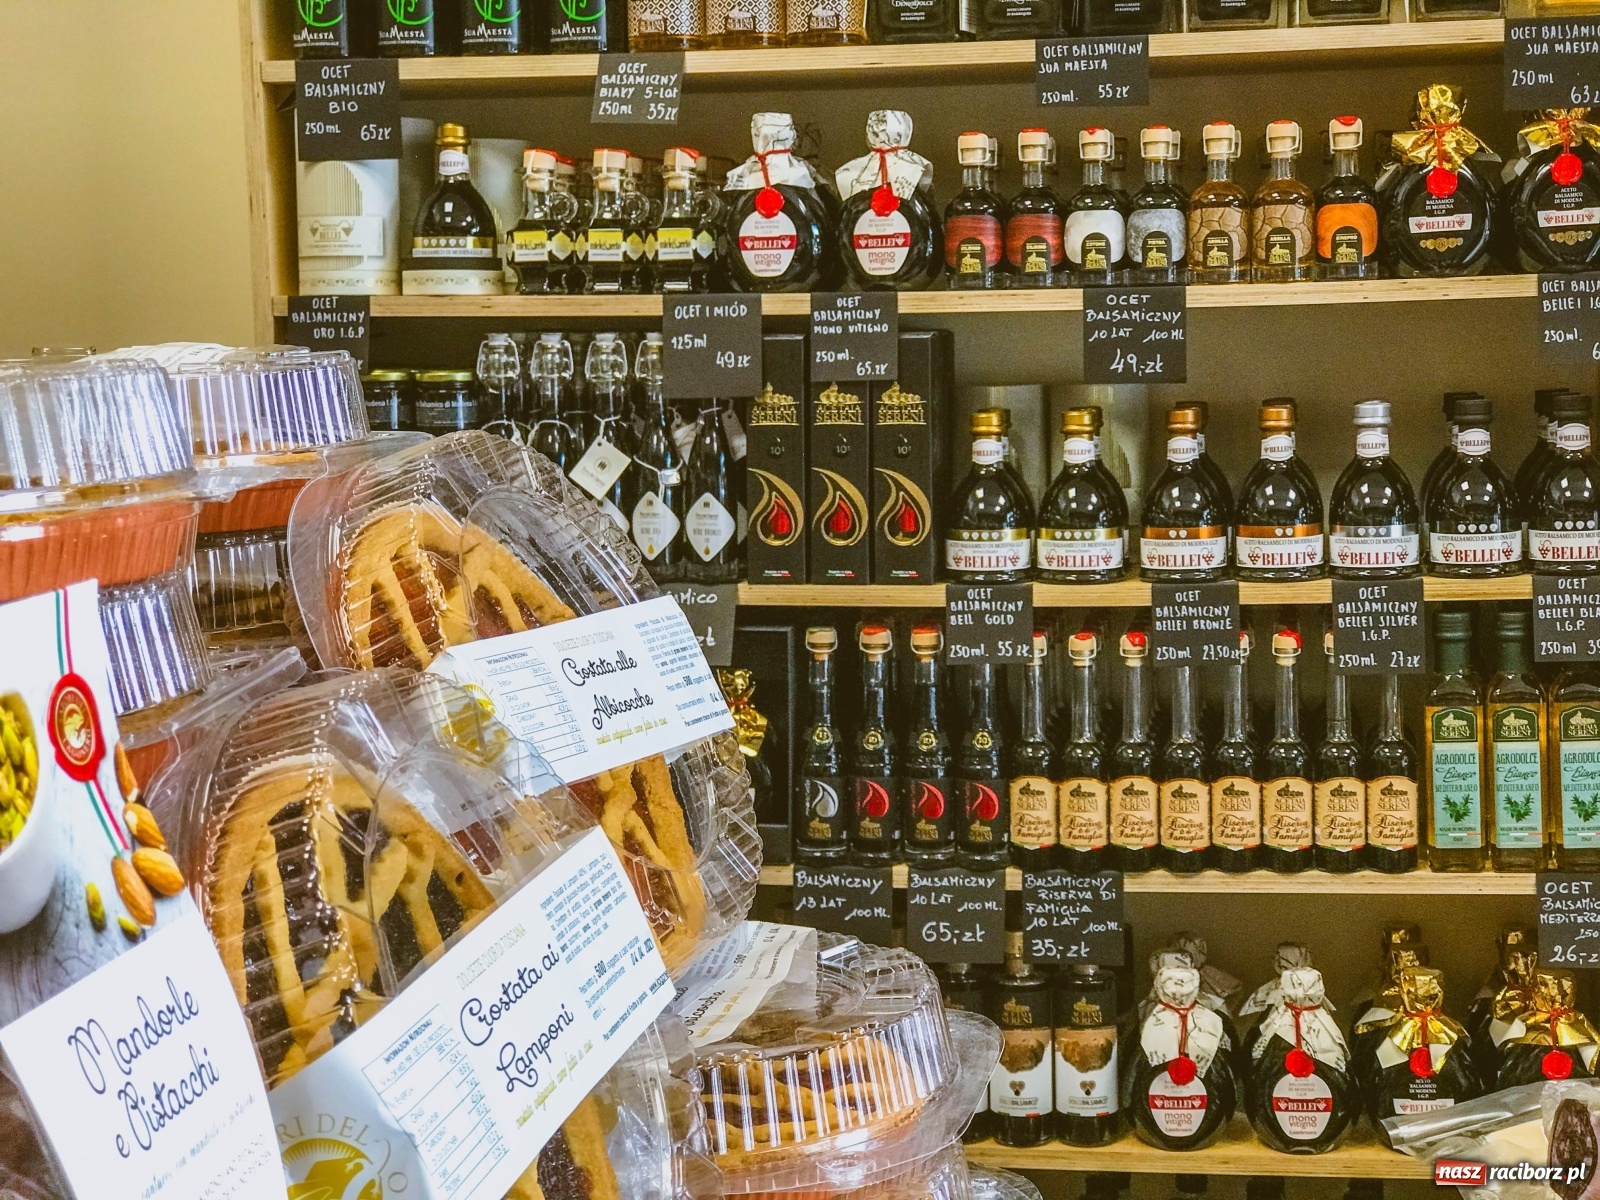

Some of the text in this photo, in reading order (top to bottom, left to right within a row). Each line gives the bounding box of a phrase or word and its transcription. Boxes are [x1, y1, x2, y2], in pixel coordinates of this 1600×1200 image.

[1511, 26, 1538, 41] OCET
[1043, 42, 1144, 60] OCET BALSAMICZNY
[1525, 41, 1600, 56] SUA MAESTA
[321, 65, 352, 79] OCET
[618, 62, 648, 75] OCET
[1039, 59, 1109, 75] SUA MAESTA
[601, 73, 678, 87] BALSAMICZNY
[304, 81, 386, 98] BALSAMICZNY
[329, 101, 358, 114] BIO
[1425, 220, 1456, 230] BELLEI
[1554, 213, 1585, 224] BELLEI
[753, 237, 783, 249] BELLEI
[867, 236, 896, 248] BELLEI
[754, 258, 782, 267] vitigno
[868, 256, 896, 266] vitigno
[1542, 279, 1566, 294] OCET
[312, 297, 339, 310] OCET
[836, 297, 862, 308] OCET
[1106, 294, 1152, 306] OCET
[1543, 297, 1581, 312] BELLEI
[674, 305, 700, 320] OCET
[714, 301, 748, 318] MIÓD
[814, 309, 881, 322] BALSAMICZNY
[292, 311, 365, 324] BALSAMICZNY
[313, 327, 335, 339] ORO
[814, 323, 889, 335] MONO VITIGNO
[1088, 329, 1108, 342] 10
[1111, 326, 1134, 339] LAT
[1142, 329, 1169, 343] 100
[751, 412, 797, 424] SERENI
[816, 412, 862, 424] SERENI
[878, 412, 925, 424] SERENI
[1465, 439, 1487, 447] BELLEI
[1563, 434, 1586, 442] BELLEI
[1056, 555, 1101, 568] BELLEI
[1158, 554, 1202, 568] BELLEI
[1262, 552, 1307, 567] BELLEI
[1350, 548, 1396, 565] BELLEI
[1454, 547, 1501, 563] BELLEI
[964, 555, 1008, 569] BELLEI
[1558, 578, 1588, 590] OCET
[967, 588, 993, 600] OCET
[1175, 590, 1202, 602] OCET
[1359, 586, 1389, 600] OCET
[950, 600, 1024, 612] BALSAMICZNY
[1155, 605, 1230, 618] BALSAMICZNY
[1338, 601, 1418, 614] BALSAMICZNY
[1538, 607, 1574, 619] BELLEI
[985, 614, 1014, 626] GOLD
[1155, 618, 1234, 631] BELLEI BRONZE
[1338, 615, 1418, 628] BELLEI SILVER
[1556, 620, 1586, 631] I.G.P.
[1362, 629, 1391, 642] I.G.P.
[561, 650, 638, 687] Crostata alle
[592, 687, 654, 730] Albicocche
[1435, 753, 1478, 765] AGRODOLCE
[1496, 752, 1539, 764] AGRODOLCE
[1435, 767, 1477, 783] Bianco
[1496, 766, 1538, 783] Bianco
[1435, 783, 1478, 793] MEDITERRANEO
[1496, 783, 1539, 792] MEDITERRANEO
[1321, 827, 1363, 843] Famiglia
[1372, 827, 1414, 842] Famiglia
[1544, 881, 1593, 895] OCET
[796, 896, 817, 911] 13
[820, 895, 847, 909] LAT
[844, 908, 872, 921] 100
[910, 893, 928, 905] 10
[931, 892, 954, 905] LAT
[957, 902, 983, 913] 100
[1026, 917, 1048, 931] 10
[1052, 917, 1080, 927] LAT
[1081, 922, 1107, 935] 100
[1574, 928, 1599, 941] 250
[594, 960, 607, 979] 500
[460, 967, 543, 1047] Crostata
[542, 943, 561, 972] ai
[68, 976, 200, 1095] Mandorle
[496, 1003, 575, 1093] Lamponi
[117, 1044, 220, 1151] Pistacchi
[1164, 1099, 1193, 1109] BELLEI
[1288, 1101, 1317, 1111] BELLEI
[1165, 1118, 1192, 1127] vitigno
[1288, 1114, 1317, 1122] mono
[316, 1113, 370, 1147] DEL
[1289, 1120, 1317, 1130] vitigno
[116, 1133, 131, 1158] e
